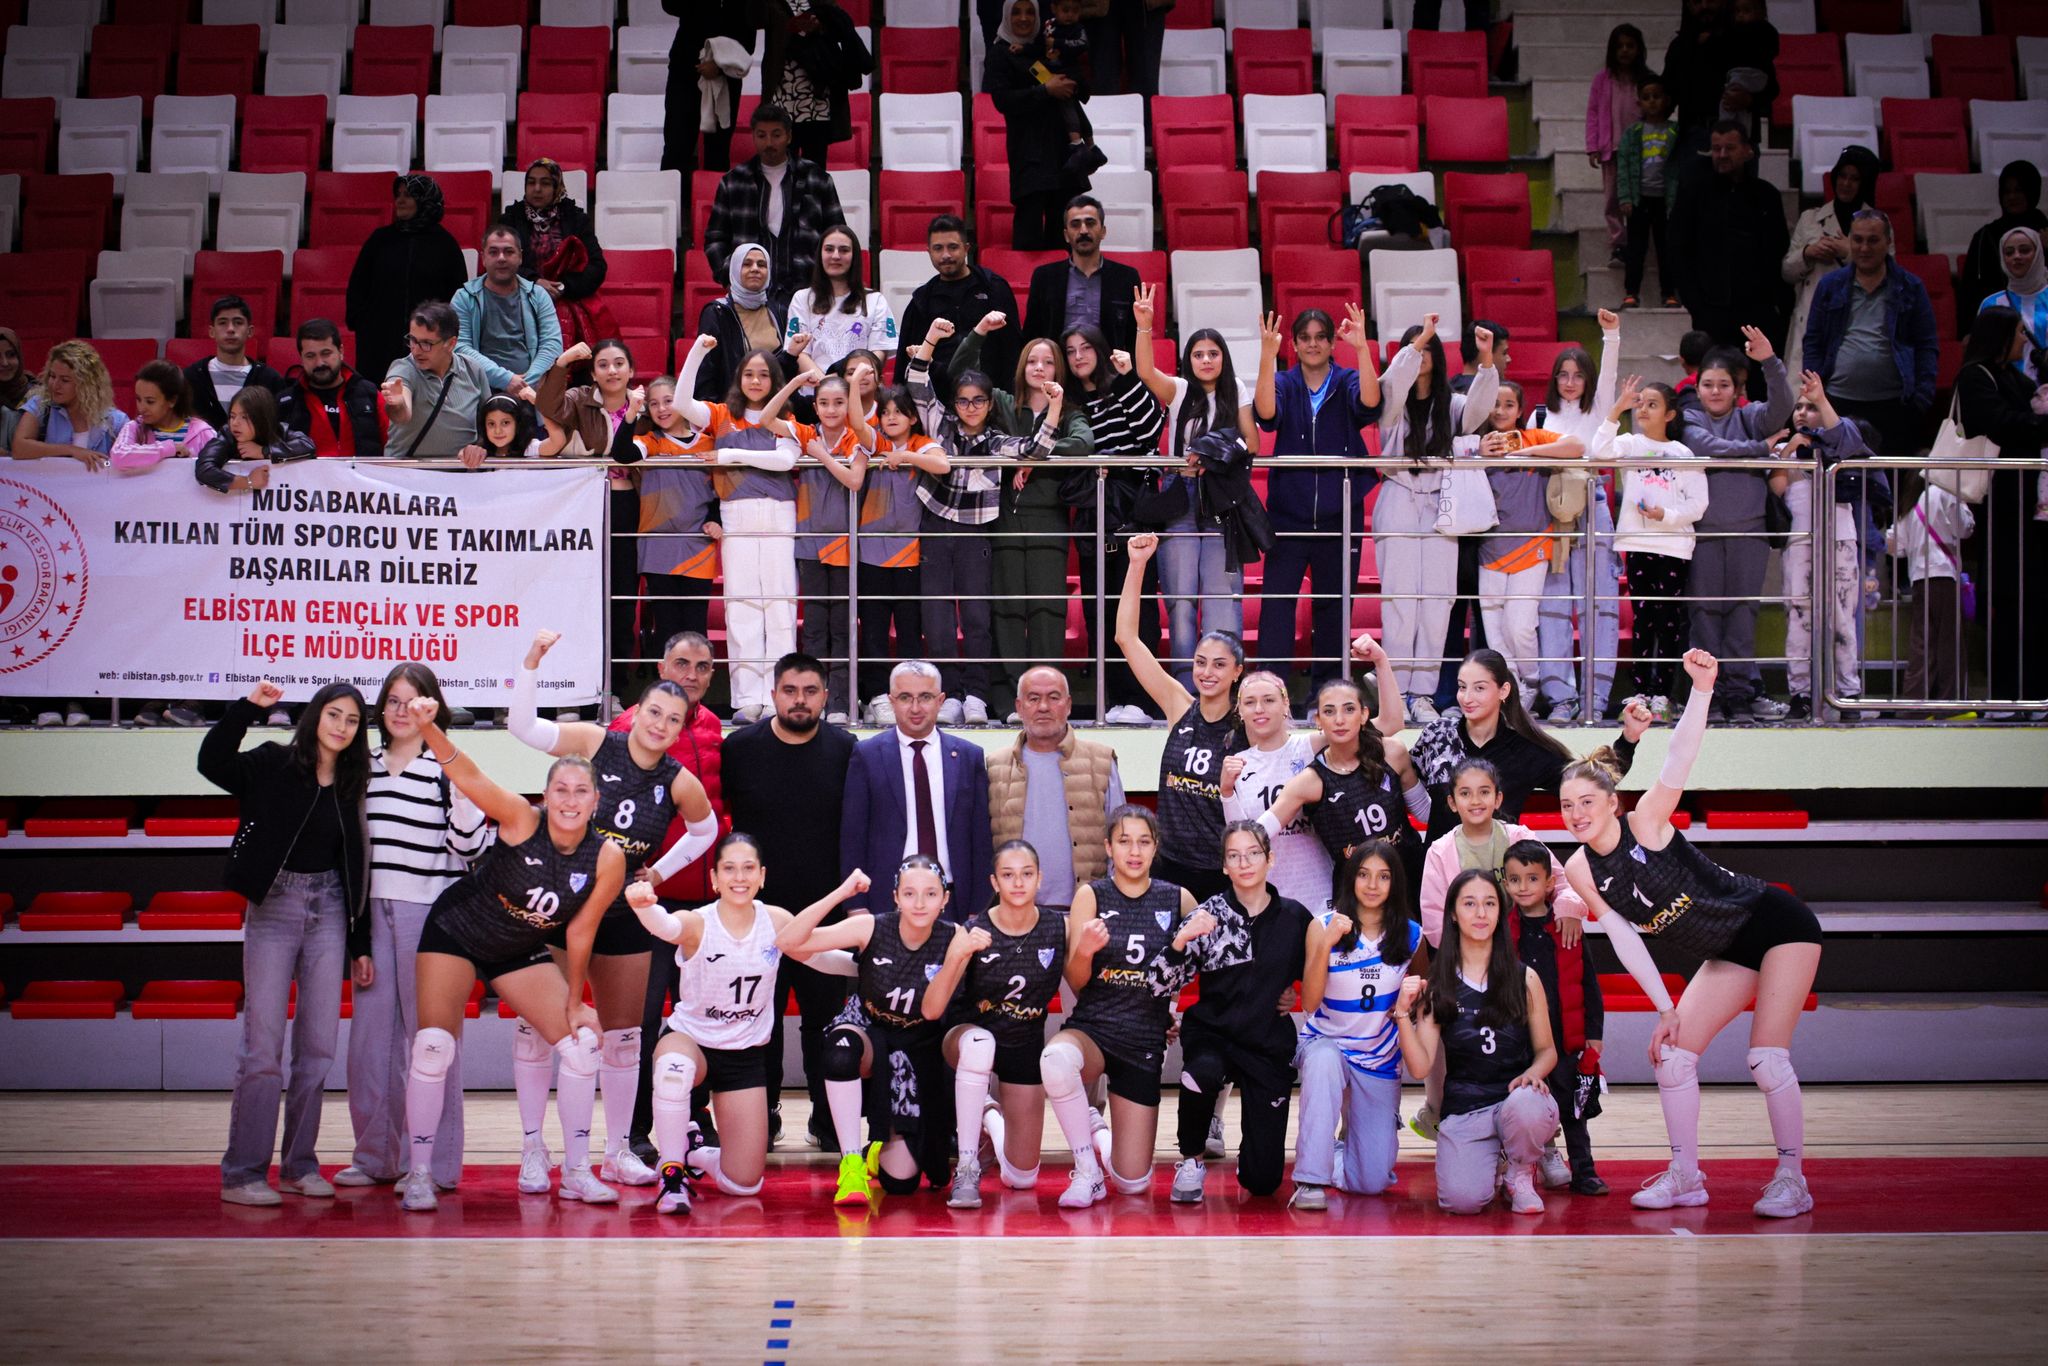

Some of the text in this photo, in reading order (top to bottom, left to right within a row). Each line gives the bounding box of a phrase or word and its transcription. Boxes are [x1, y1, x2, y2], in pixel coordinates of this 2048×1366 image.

[252, 483, 458, 517] MÜSABAKALARA
[1436, 466, 1453, 528] DeFac
[115, 517, 594, 552] KATILAN TÜM SPORCU VE TAKIMLARA
[36, 545, 52, 579] SPOR
[229, 555, 478, 587] BAŞARILAR DİLERİZ
[4, 582, 51, 636] BAKANLIĞI
[184, 593, 519, 631] ELBİSTAN GENÇLİK VE SPOR
[242, 627, 458, 663] İLÇE MÜDÜRLÜĞÜ
[98, 671, 120, 680] web:
[225, 673, 261, 683] Elbistan
[298, 676, 309, 685] ve
[311, 675, 332, 687] Spor
[352, 676, 385, 686] Müdürl
[436, 676, 498, 690] lbistan_GSİM
[536, 678, 576, 690] stangsim
[1183, 746, 1213, 775] 18
[613, 799, 636, 830] 8
[1354, 803, 1387, 837] 19
[525, 886, 560, 917] 10
[1125, 934, 1146, 965] 5
[728, 974, 763, 1005] 17
[1004, 974, 1027, 1001] 2
[1109, 968, 1149, 982] KAPL
[885, 986, 916, 1015] 11
[1360, 983, 1377, 1012] 8
[1479, 1026, 1497, 1055] 3
